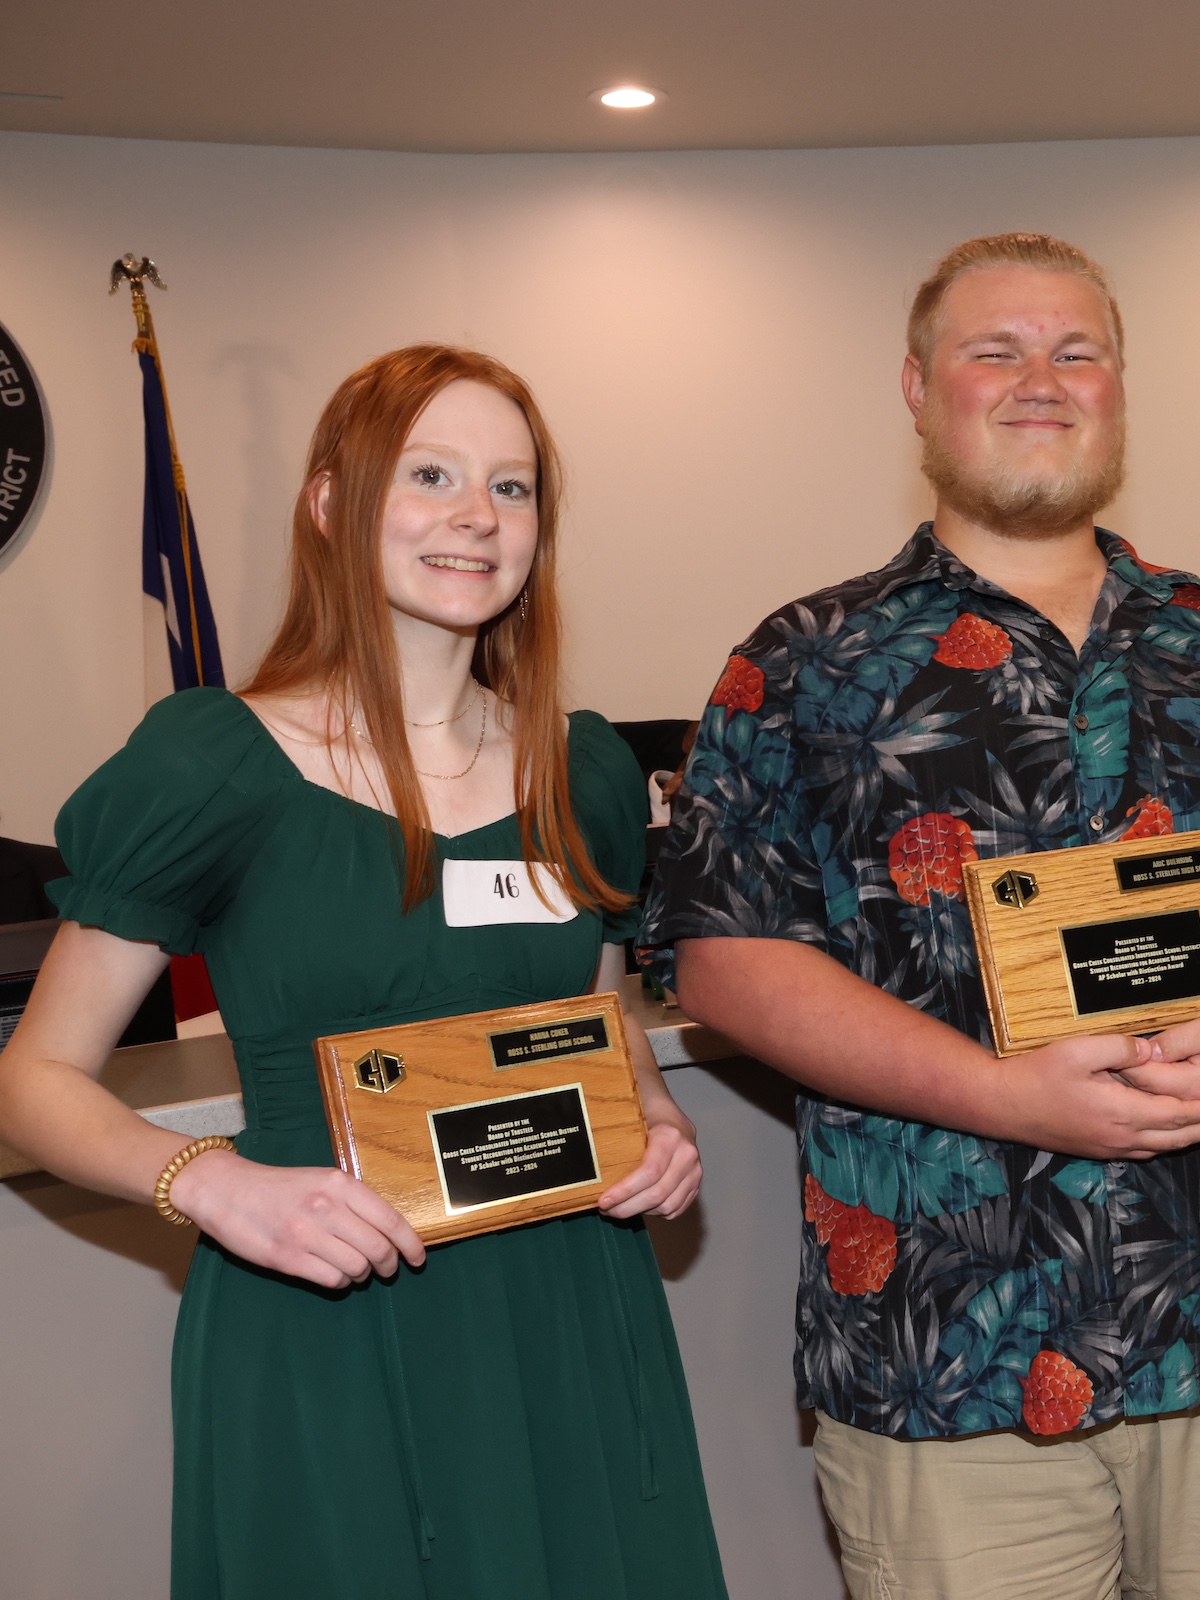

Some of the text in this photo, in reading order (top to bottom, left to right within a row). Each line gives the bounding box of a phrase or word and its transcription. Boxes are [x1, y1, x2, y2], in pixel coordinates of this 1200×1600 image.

[0, 448, 30, 521] RICT
[1133, 873, 1148, 881] ROSS
[1155, 868, 1180, 878] STERLING
[1181, 866, 1195, 874] HIGH
[493, 873, 520, 899] 46
[1115, 938, 1139, 946] PRESENTED
[1136, 943, 1158, 951] TRUSTEES
[1103, 955, 1135, 964] CONSOLIDATED
[1135, 950, 1164, 959] INDEPENDENT
[1110, 962, 1139, 971] RECOGNITION
[1148, 957, 1170, 965] ACADEMIC
[1106, 972, 1126, 980] Scholar
[1139, 965, 1167, 974] Distinction
[507, 1047, 523, 1057] ROSS
[531, 1041, 557, 1052] STERLING
[558, 1039, 572, 1048] HIGH
[573, 1035, 595, 1045] SCHOOL
[488, 1122, 514, 1132] PRESENTED
[488, 1133, 504, 1141] BOARD
[511, 1127, 533, 1136] TRUSTEES
[443, 1126, 579, 1159] GOOSE CREEK CONSOLIDATED INDEPENDENT SCHOOL DISTRICT
[461, 1155, 482, 1164] STUDENT
[482, 1149, 514, 1160] RECOGNITION
[524, 1142, 547, 1151] ACADEMIC
[547, 1138, 566, 1146] HONORS
[478, 1161, 500, 1170] Scholar
[500, 1157, 513, 1165] with
[513, 1152, 543, 1162] Distinction
[544, 1147, 561, 1156] Award
[506, 1166, 520, 1175] 2023
[523, 1163, 537, 1171] 2024
